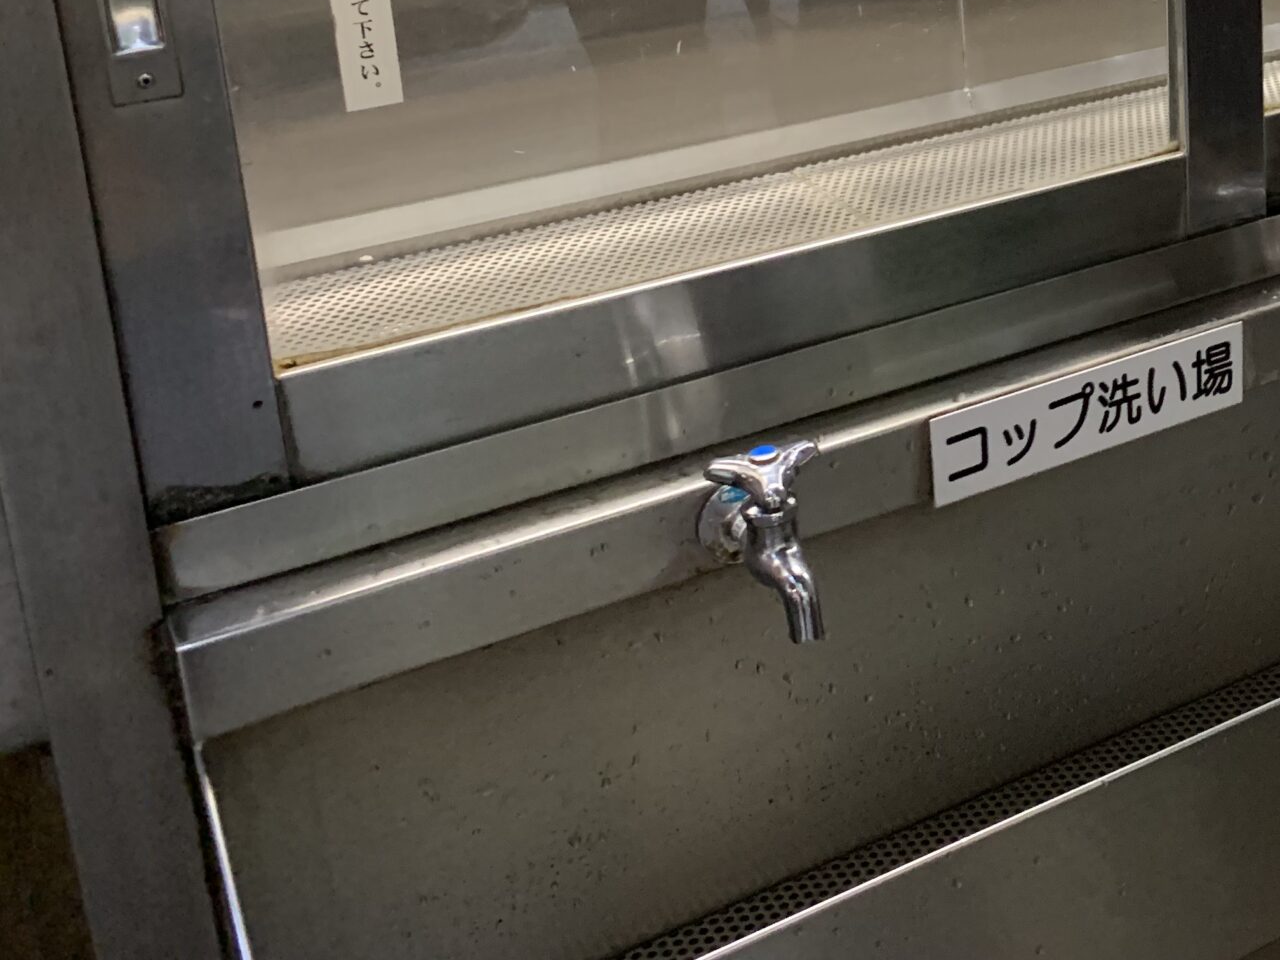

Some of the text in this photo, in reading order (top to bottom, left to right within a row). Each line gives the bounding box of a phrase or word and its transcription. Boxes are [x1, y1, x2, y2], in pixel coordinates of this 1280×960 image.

[945, 340, 1234, 482] コップ洗い場
